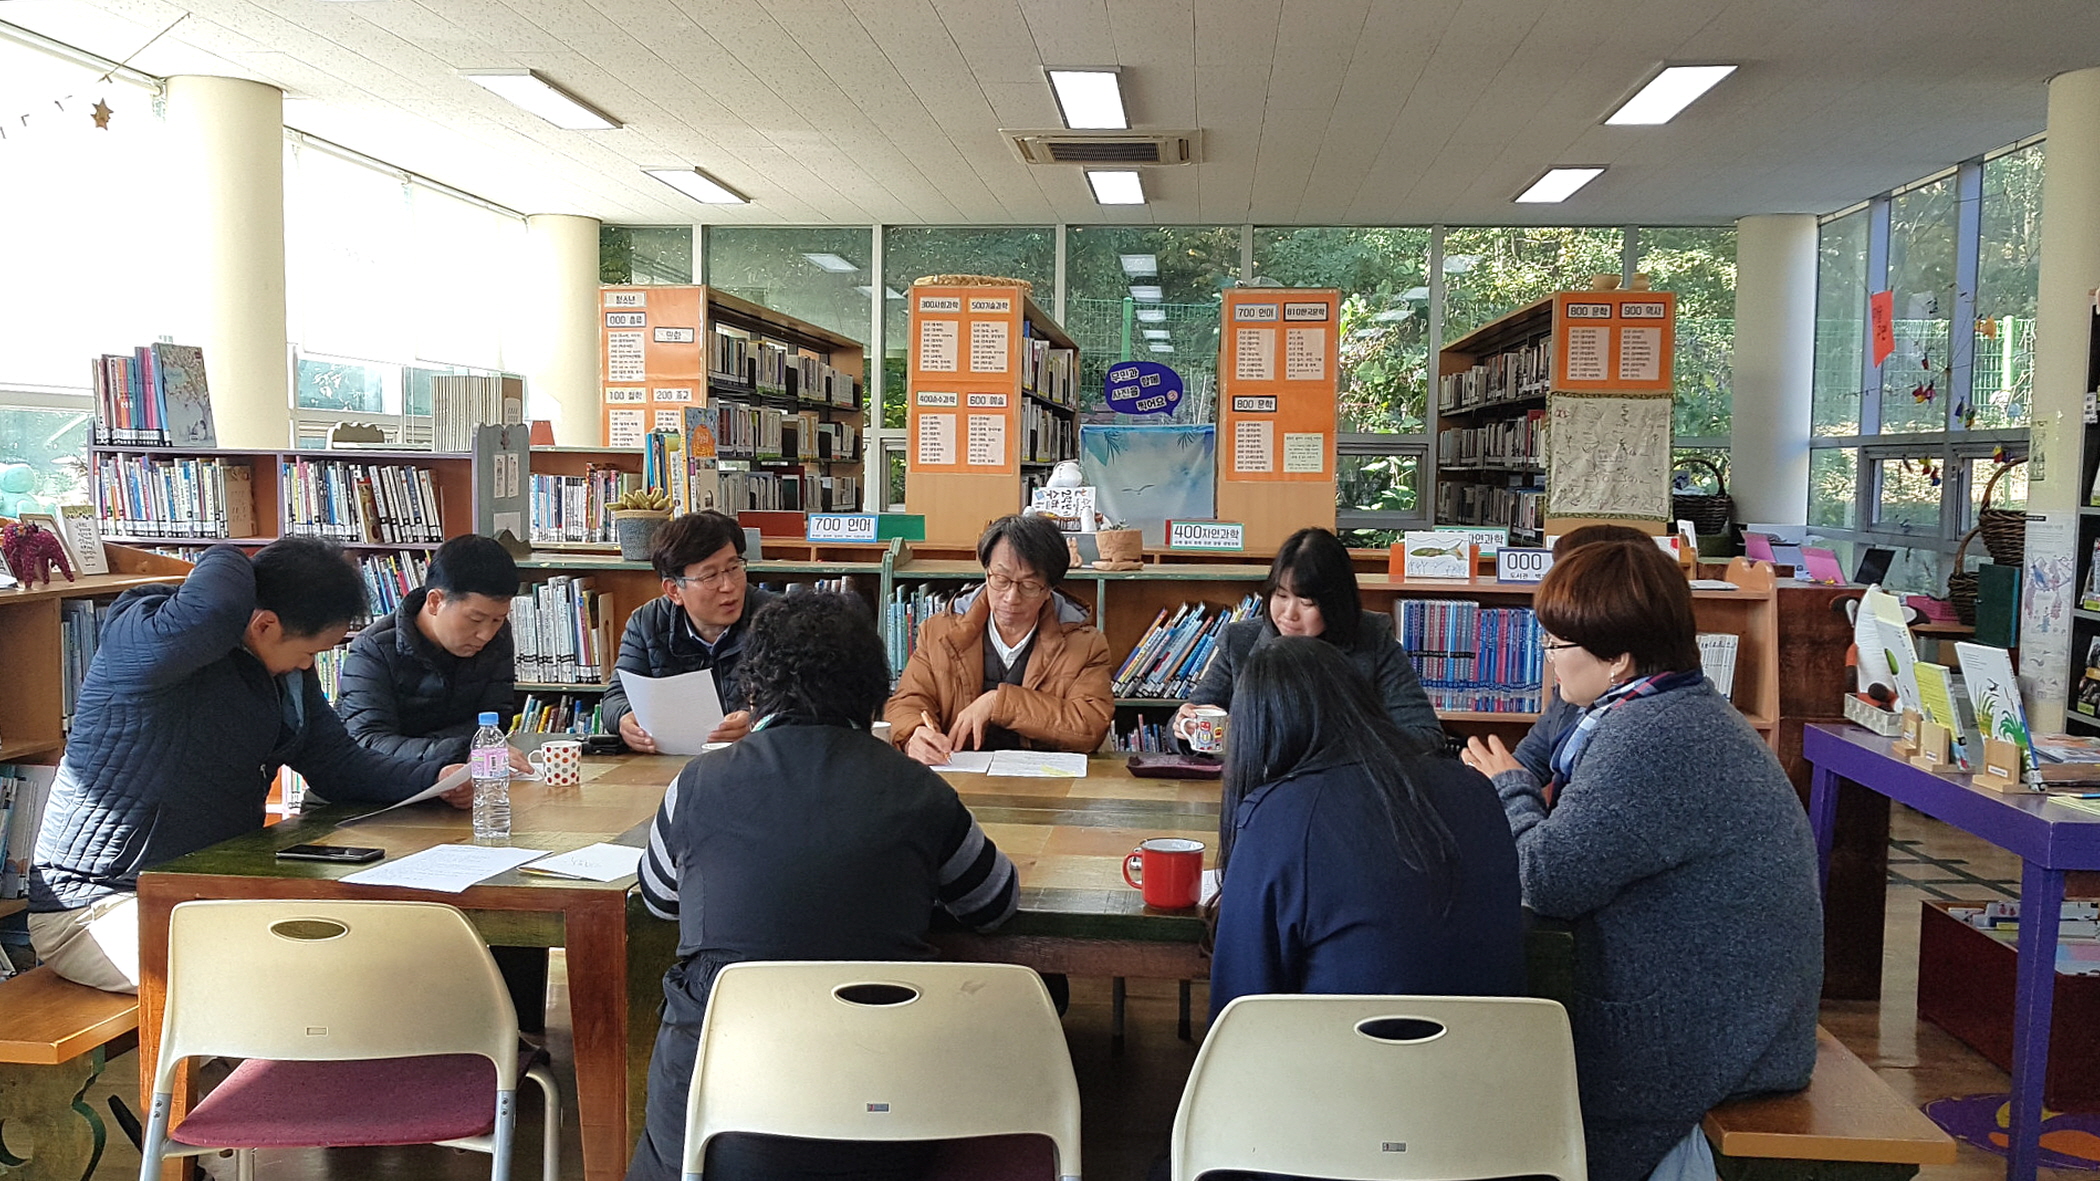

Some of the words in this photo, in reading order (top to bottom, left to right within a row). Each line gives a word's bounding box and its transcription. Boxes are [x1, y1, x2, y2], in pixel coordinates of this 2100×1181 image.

[1238, 308, 1254, 318] 700
[1258, 308, 1274, 318] 언어
[1570, 306, 1588, 316] 800
[1592, 306, 1608, 316] 문학
[1624, 306, 1642, 315] 900
[610, 315, 626, 325] 000
[1141, 374, 1159, 386] 함께
[610, 391, 624, 400] 100
[656, 390, 672, 400] 200
[1113, 387, 1138, 399] 사진을
[970, 396, 986, 405] 600
[1138, 397, 1165, 409] 찍어요
[1236, 400, 1254, 409] 800
[1258, 400, 1273, 409] 문학
[815, 518, 840, 531] 700
[848, 518, 871, 532] 언어
[1174, 525, 1239, 538] 400자연과학
[1507, 553, 1541, 570] 000
